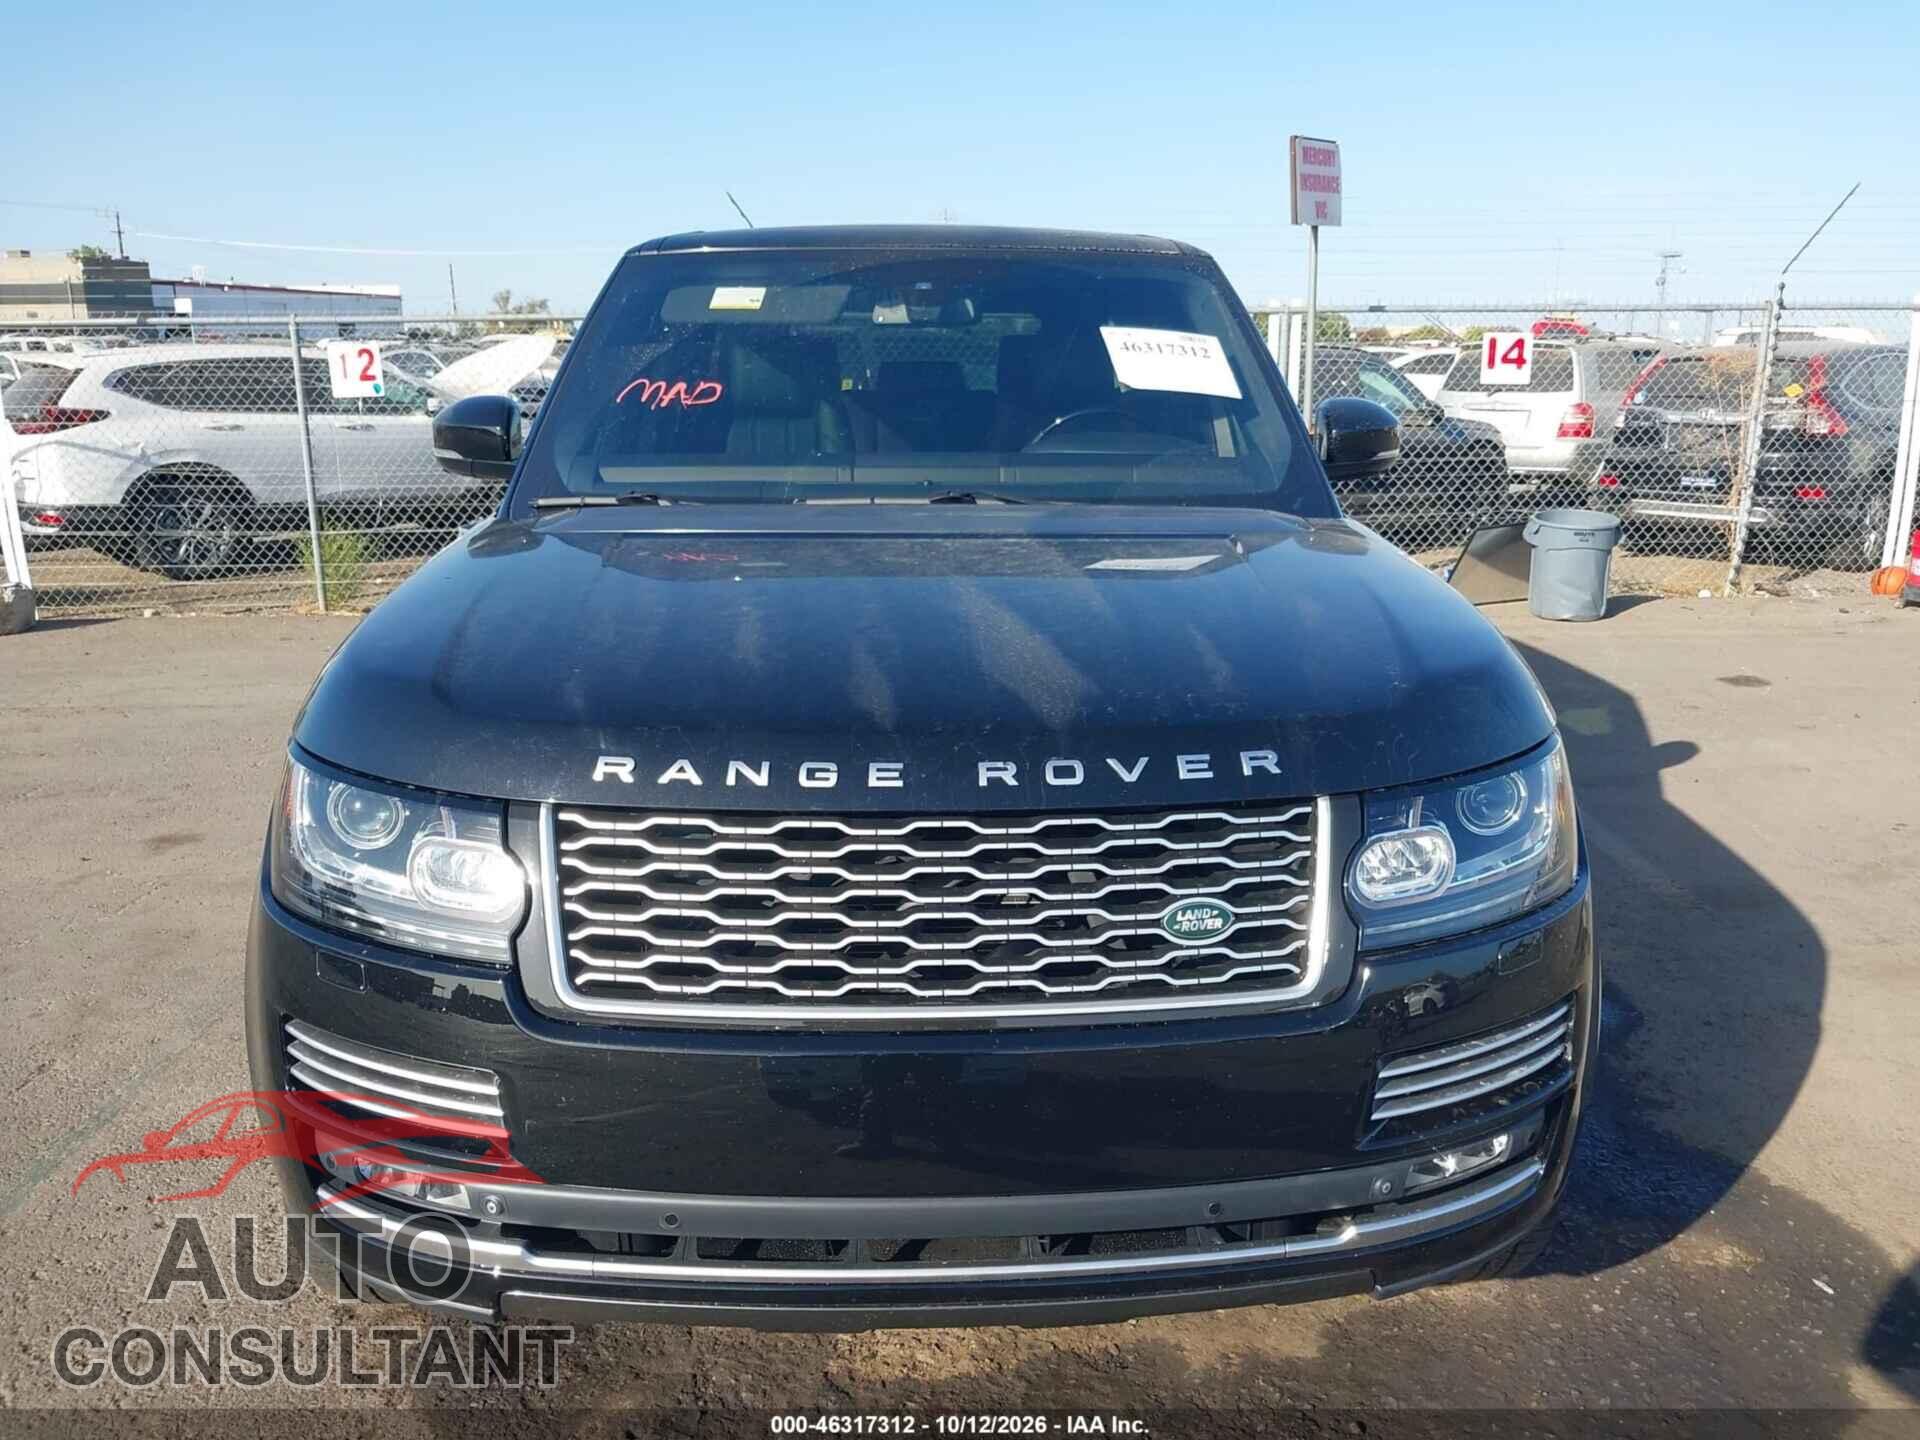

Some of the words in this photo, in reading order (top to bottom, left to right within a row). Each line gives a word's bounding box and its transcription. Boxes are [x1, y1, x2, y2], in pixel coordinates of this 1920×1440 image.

[340, 348, 376, 381] 12
[1120, 341, 1211, 359] 46317312
[1488, 337, 1527, 370] 14
[592, 755, 905, 788] RANGE
[977, 750, 1282, 787] ROVER
